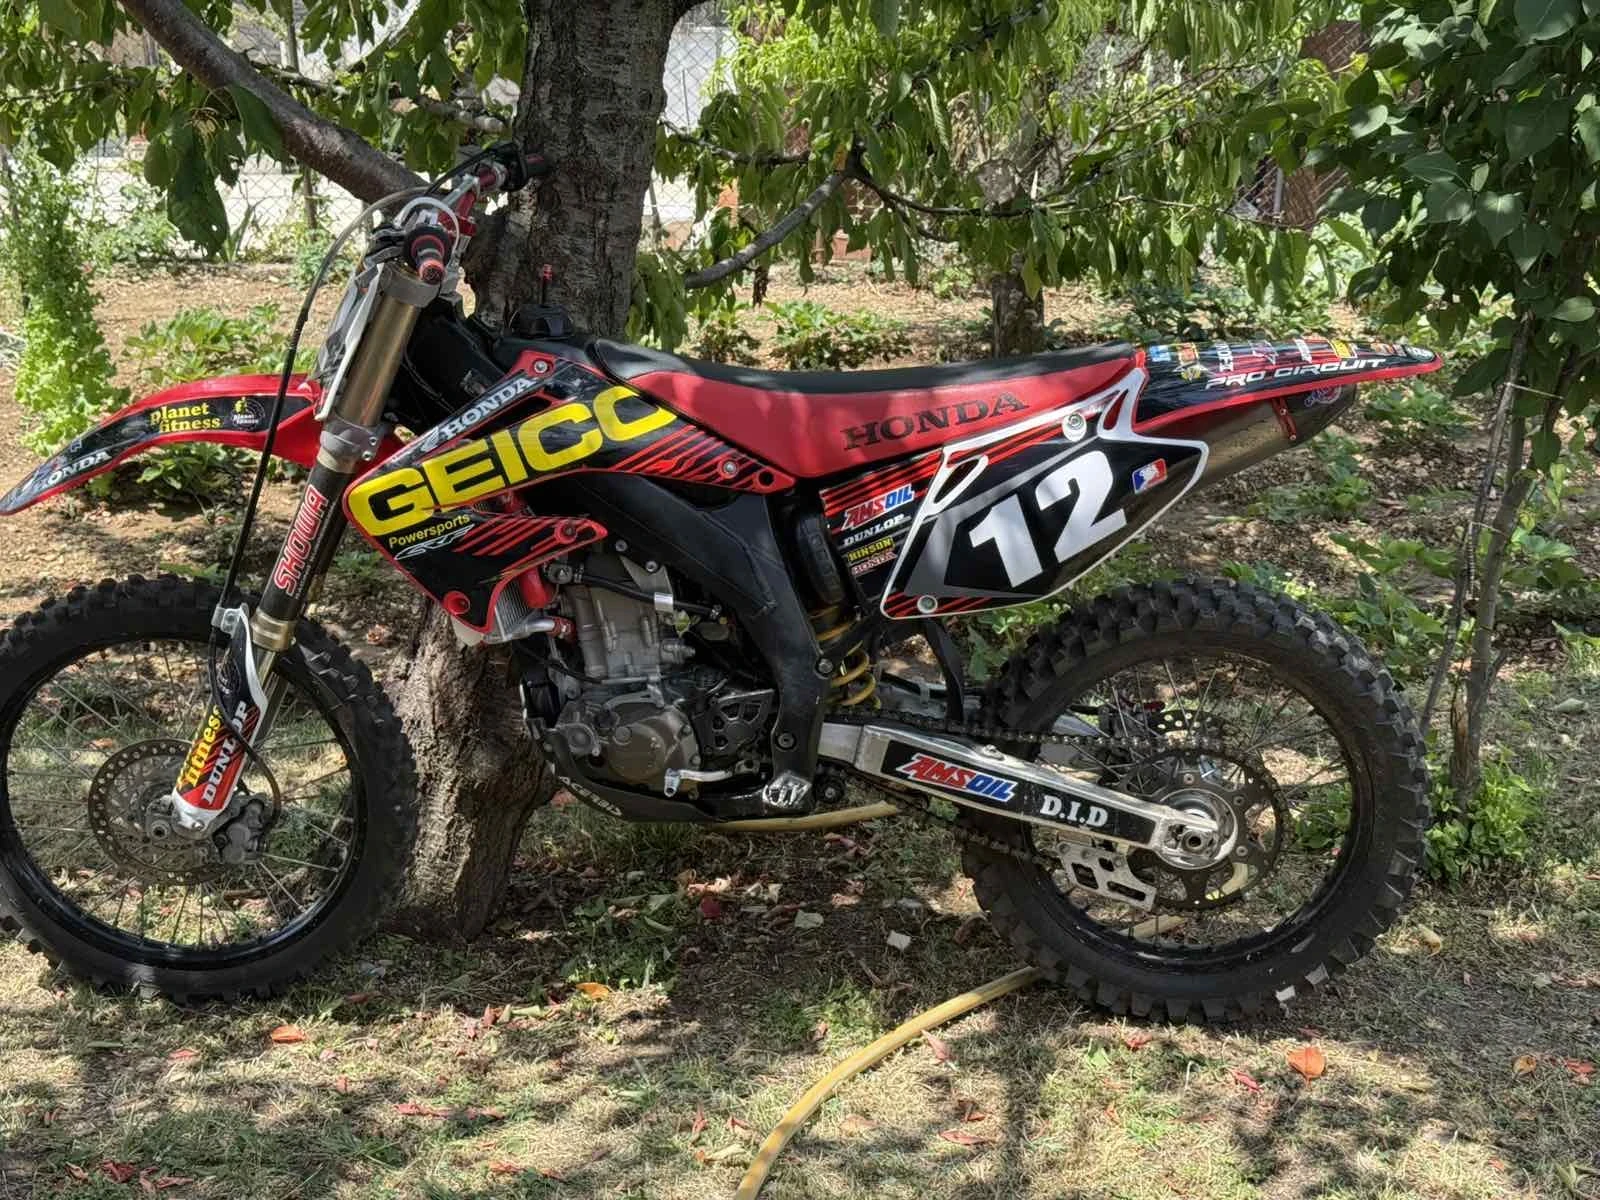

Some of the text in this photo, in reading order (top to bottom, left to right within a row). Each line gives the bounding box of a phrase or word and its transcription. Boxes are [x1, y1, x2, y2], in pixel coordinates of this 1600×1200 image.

[1205, 358, 1387, 390] PRO CIRCUIT
[150, 402, 210, 426] planet
[440, 377, 537, 441] HONDA
[840, 391, 1028, 450] HONDA
[347, 385, 678, 538] GEICO
[388, 513, 471, 549] Powersports
[841, 483, 915, 531] AMSOIL
[842, 513, 906, 547] DUNLOP
[967, 450, 1128, 588] 12
[273, 483, 329, 598] SHOWA
[896, 752, 1019, 802] AMSOIL
[1039, 794, 1108, 828] D.I.D
